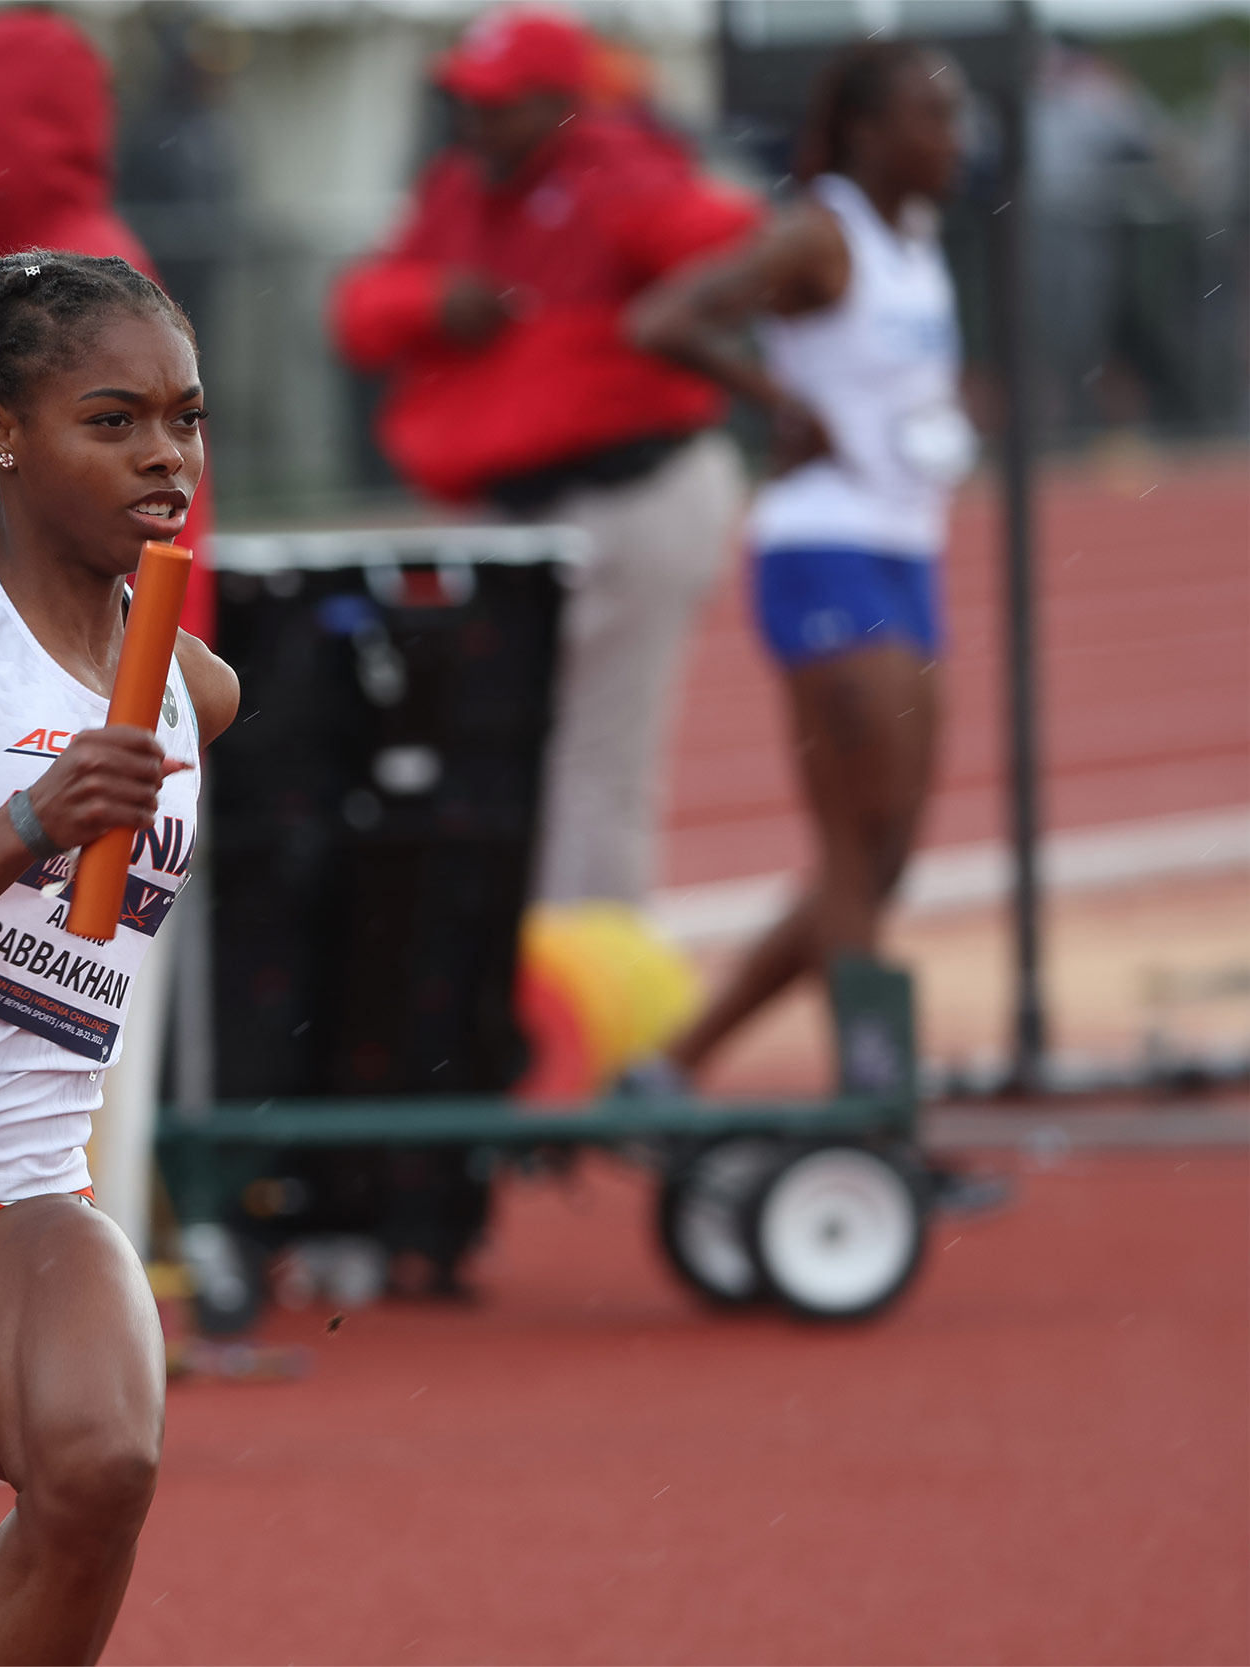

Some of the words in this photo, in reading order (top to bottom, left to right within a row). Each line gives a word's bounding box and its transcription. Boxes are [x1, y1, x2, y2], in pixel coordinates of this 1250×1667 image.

[2, 997, 34, 1015] BEYNON
[32, 1009, 57, 1026] SPORTS
[57, 1021, 76, 1035] APRIL
[8, 985, 31, 1000] FIELD
[35, 995, 69, 1018] VIRGINIA
[69, 1011, 110, 1034] CHALLENGE
